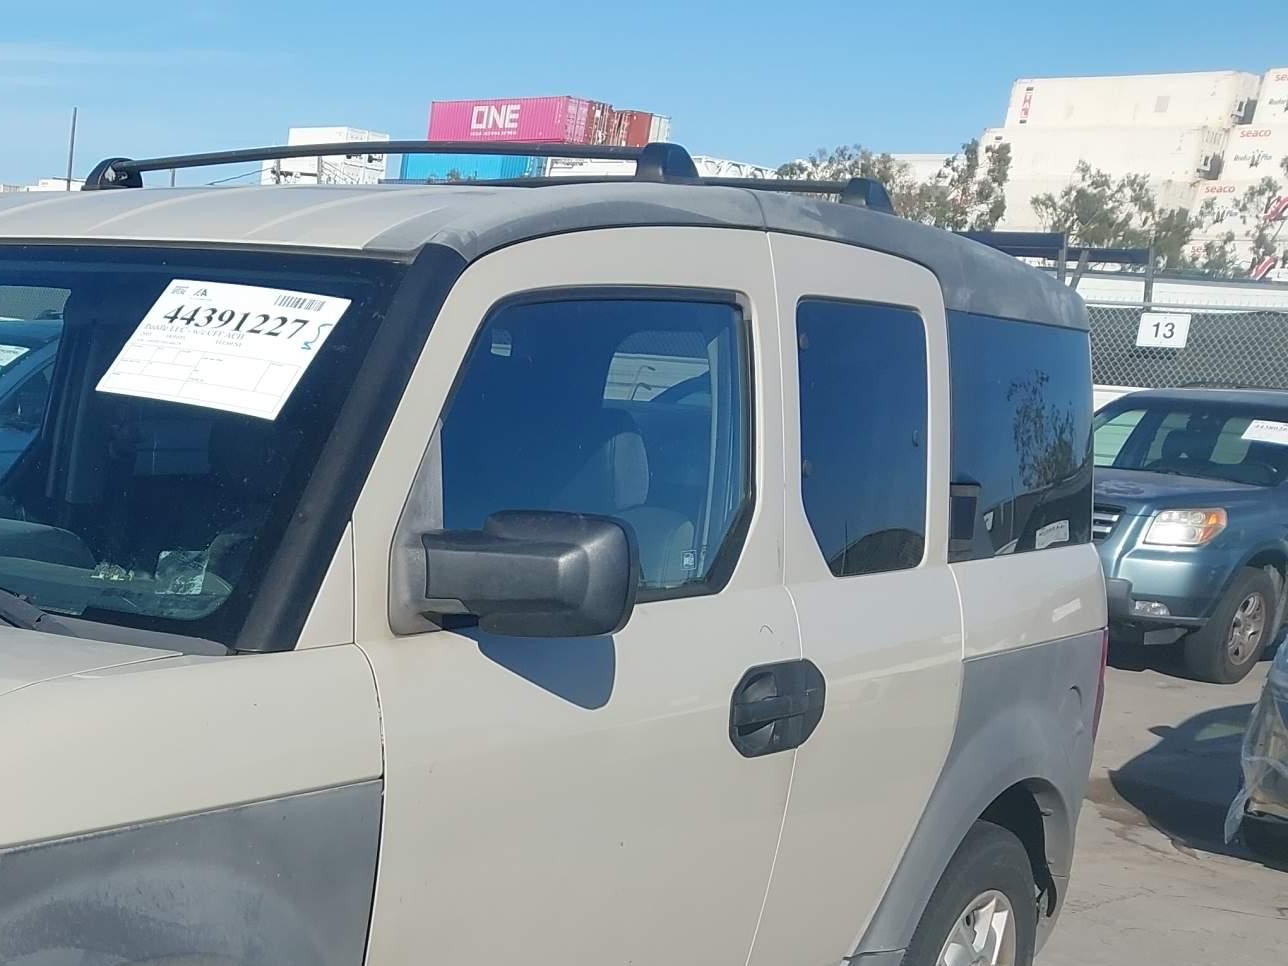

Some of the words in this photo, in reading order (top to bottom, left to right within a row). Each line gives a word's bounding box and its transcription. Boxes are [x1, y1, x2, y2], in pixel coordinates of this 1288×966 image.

[470, 104, 520, 129] ONE
[1239, 129, 1272, 138] seaco
[1204, 185, 1236, 193] seaco
[163, 304, 309, 340] 44391227
[1152, 322, 1175, 339] 13
